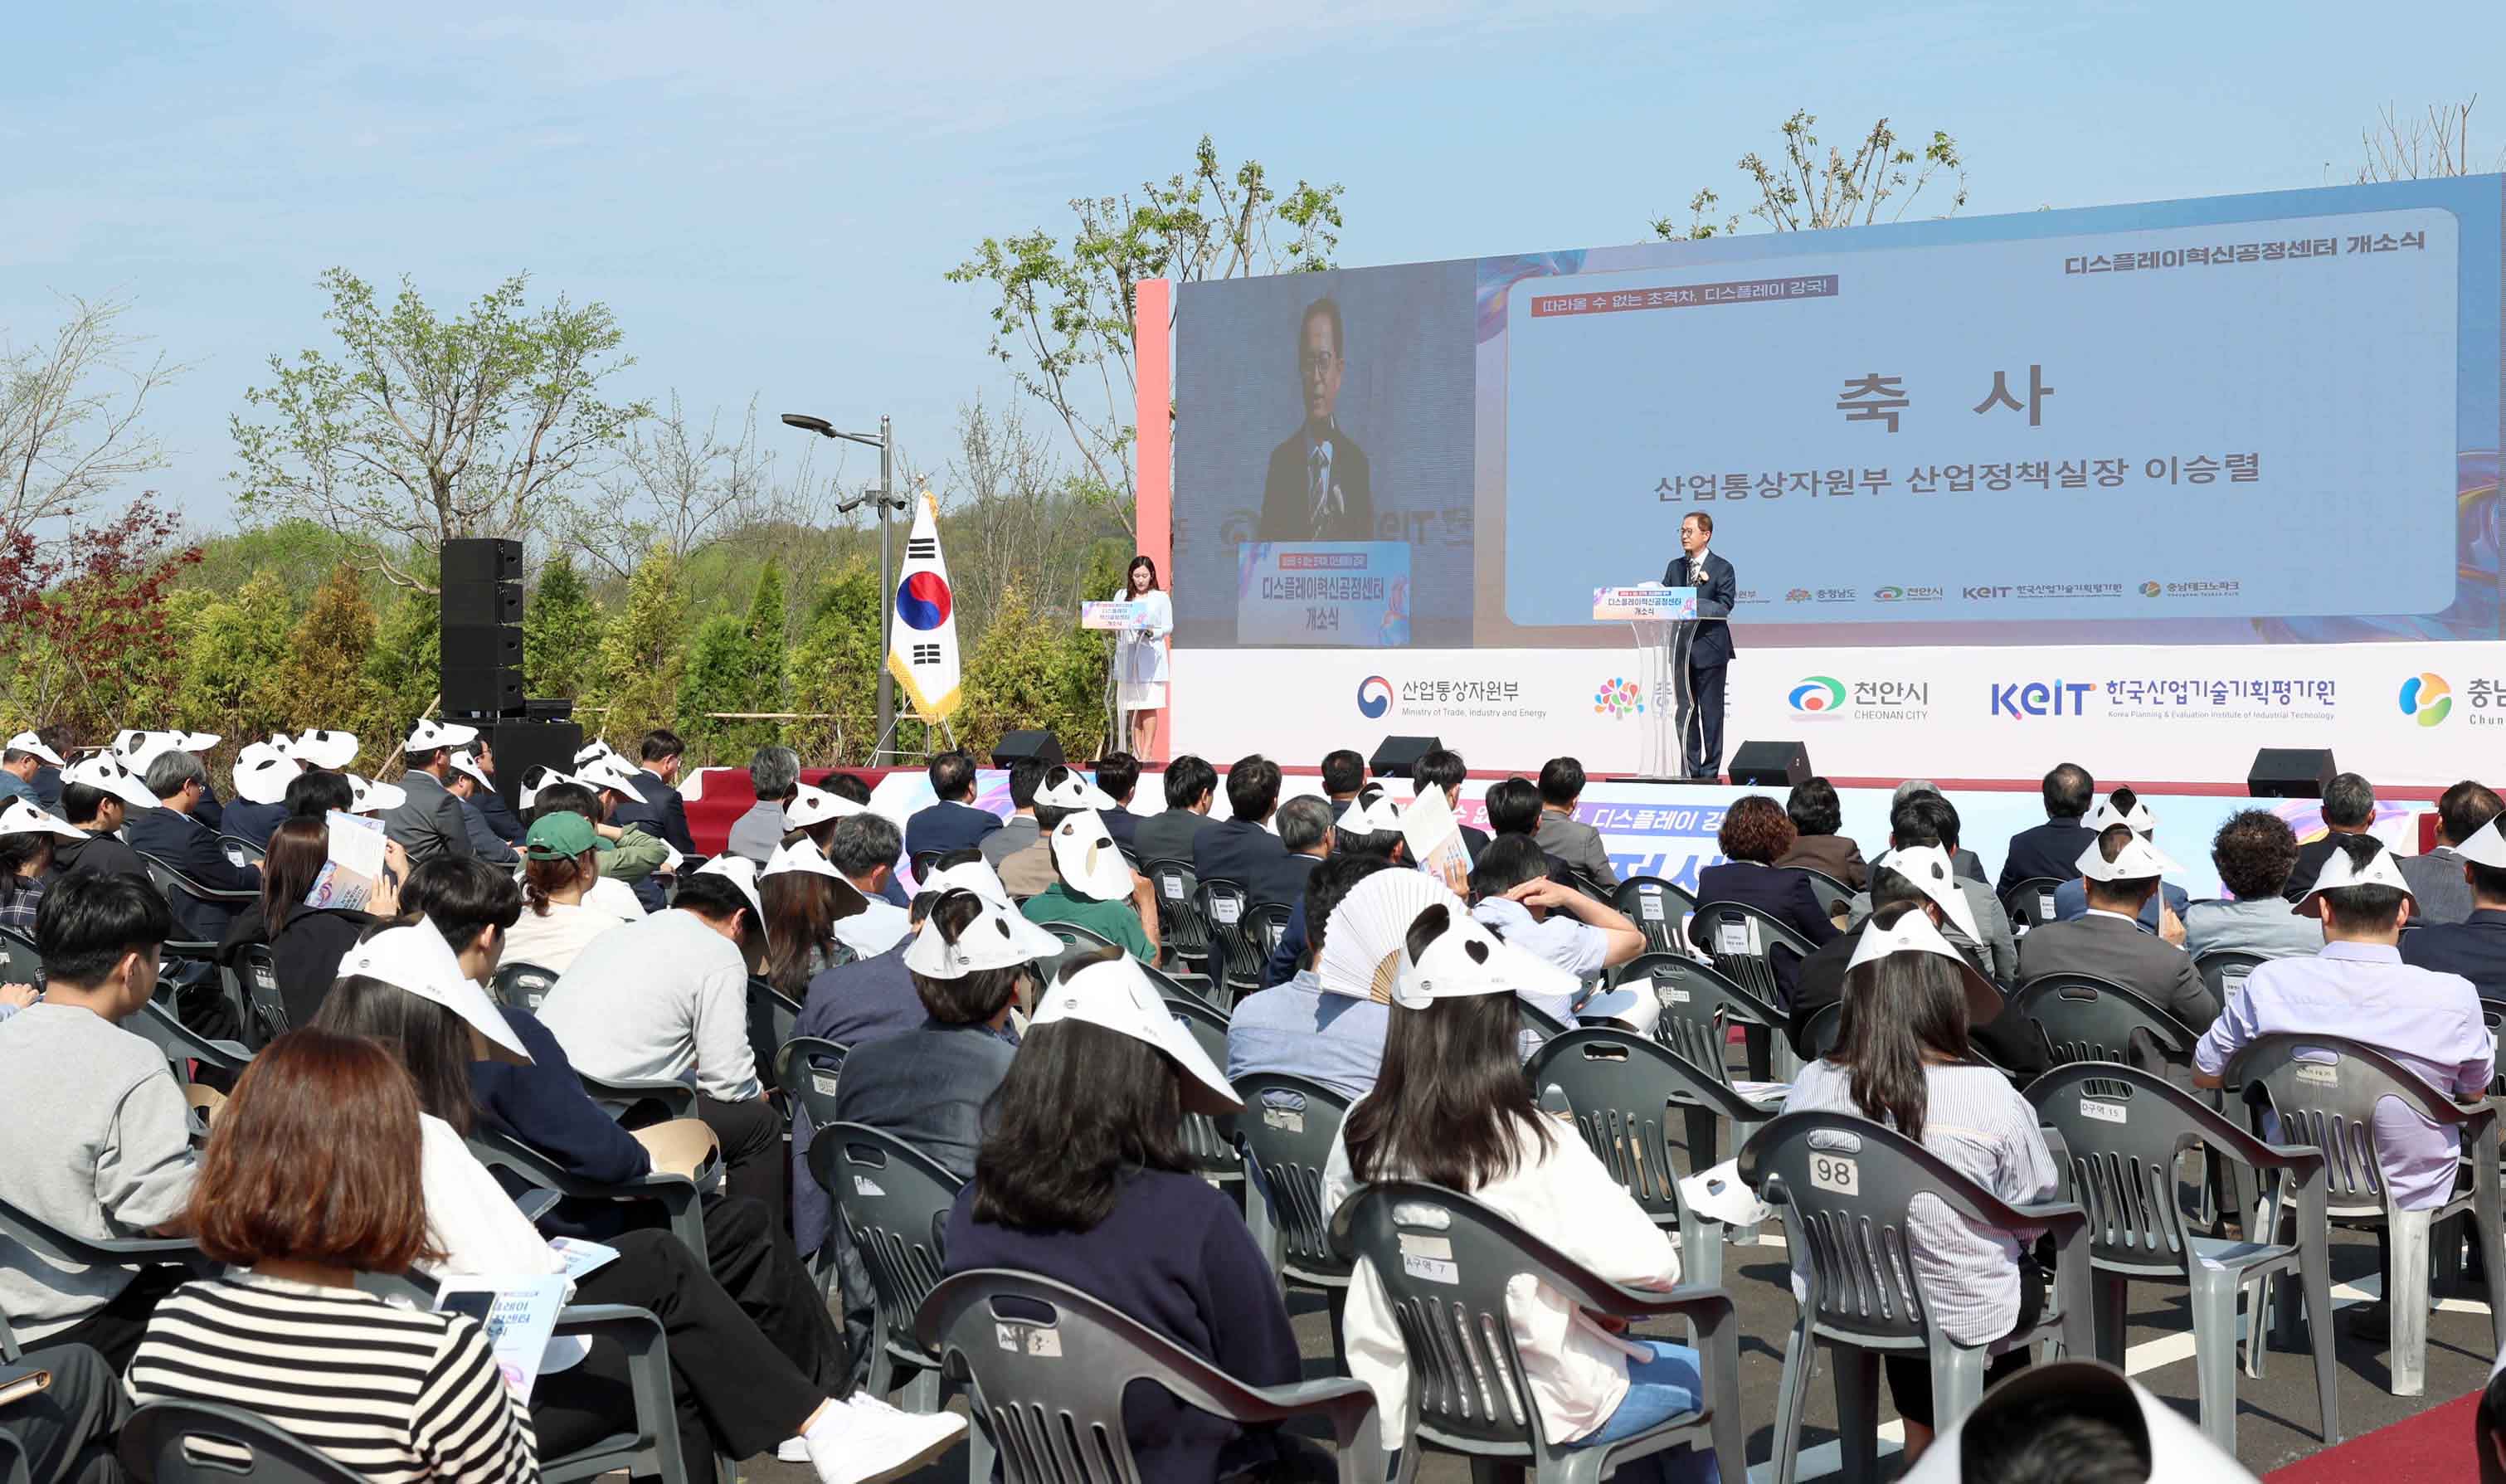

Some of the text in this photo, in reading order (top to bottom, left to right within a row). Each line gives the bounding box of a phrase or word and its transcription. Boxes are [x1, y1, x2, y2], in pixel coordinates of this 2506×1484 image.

[2064, 231, 2426, 275] 디스플레이혁신공정센터 개소식
[1543, 280, 1827, 313] 따라올 수 없는 초격차, 디스플레이 강국!
[1836, 364, 2055, 433] 축 사
[1654, 452, 2261, 503] 산업통상자원부 산업정책실장 이승렬
[1262, 577, 1384, 601] 디스플레이혁신공정센터
[1306, 607, 1340, 631] 개소식
[1402, 680, 1520, 703] 산업통상자원부
[1854, 681, 1929, 706] 천안시
[2105, 679, 2336, 706] 한국산업기술기획평가원
[1402, 708, 1432, 718] Ministry
[1433, 708, 1441, 716] of
[1443, 708, 1467, 718] Trade,
[1469, 708, 1500, 718] Industry
[1520, 709, 1546, 720] Energy
[1854, 710, 1929, 720] CHEONAN CITY
[2130, 711, 2162, 719] Planning
[2291, 711, 2334, 720] Technology
[1591, 809, 1699, 830] 디스플레이
[1817, 1158, 1851, 1185] 98
